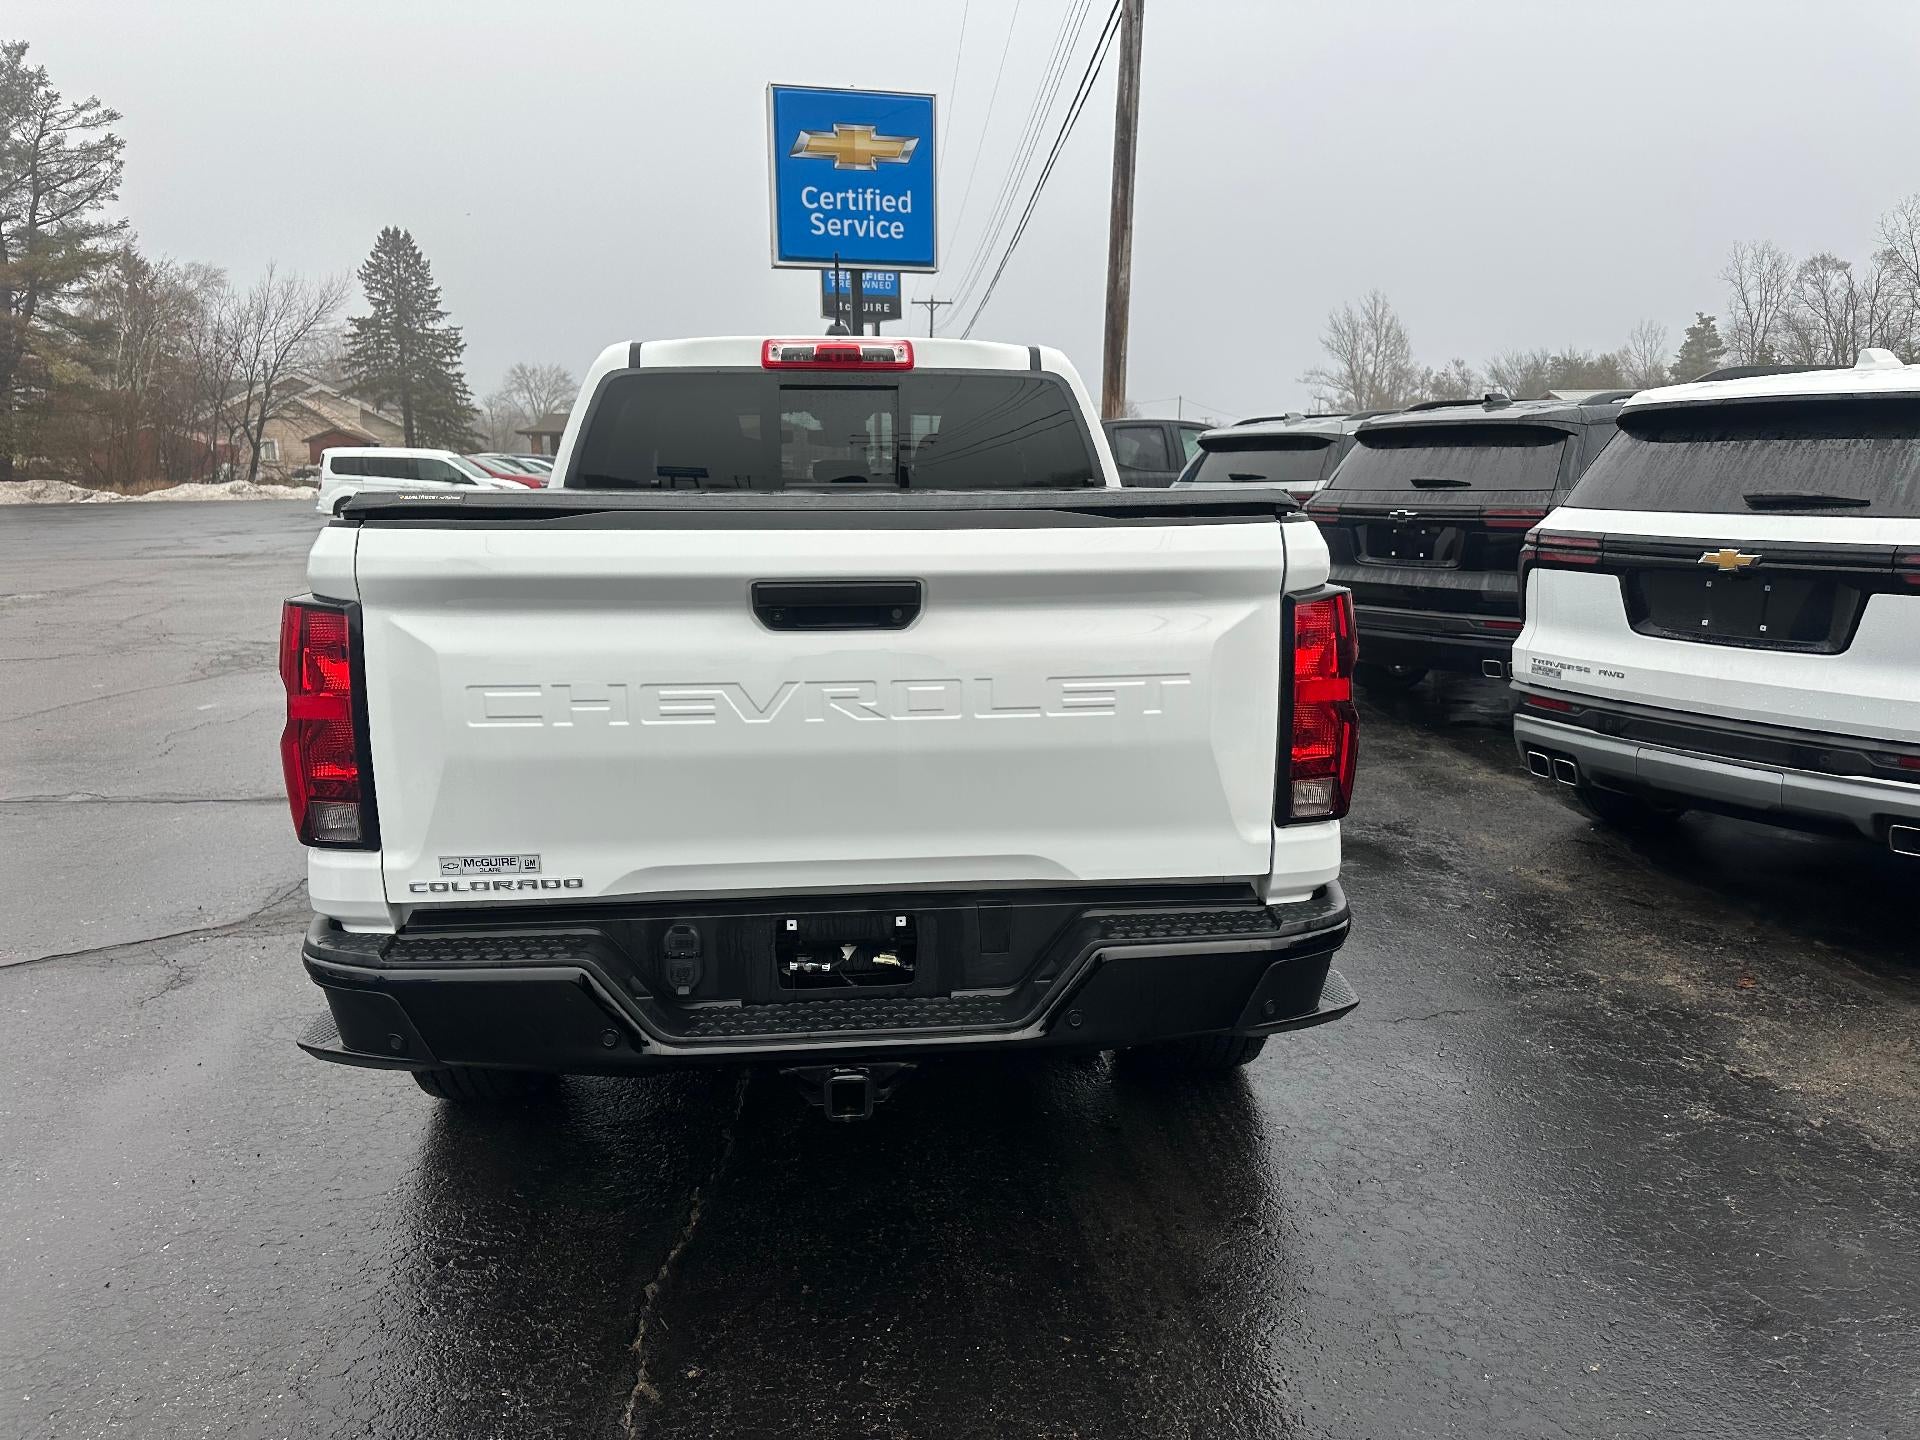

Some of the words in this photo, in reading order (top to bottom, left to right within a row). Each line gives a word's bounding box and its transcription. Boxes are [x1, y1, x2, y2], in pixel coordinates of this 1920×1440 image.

[801, 186, 912, 213] Certified
[810, 213, 905, 239] Service
[828, 271, 895, 281] CERIFIED
[857, 281, 892, 289] WNED
[1532, 657, 1591, 673] TRAVERSE
[1598, 669, 1625, 679] AWD
[466, 673, 1191, 727] CHEVROLET
[463, 857, 517, 867] McGUIRE
[524, 859, 536, 867] GM
[409, 878, 583, 893] COLORADO
